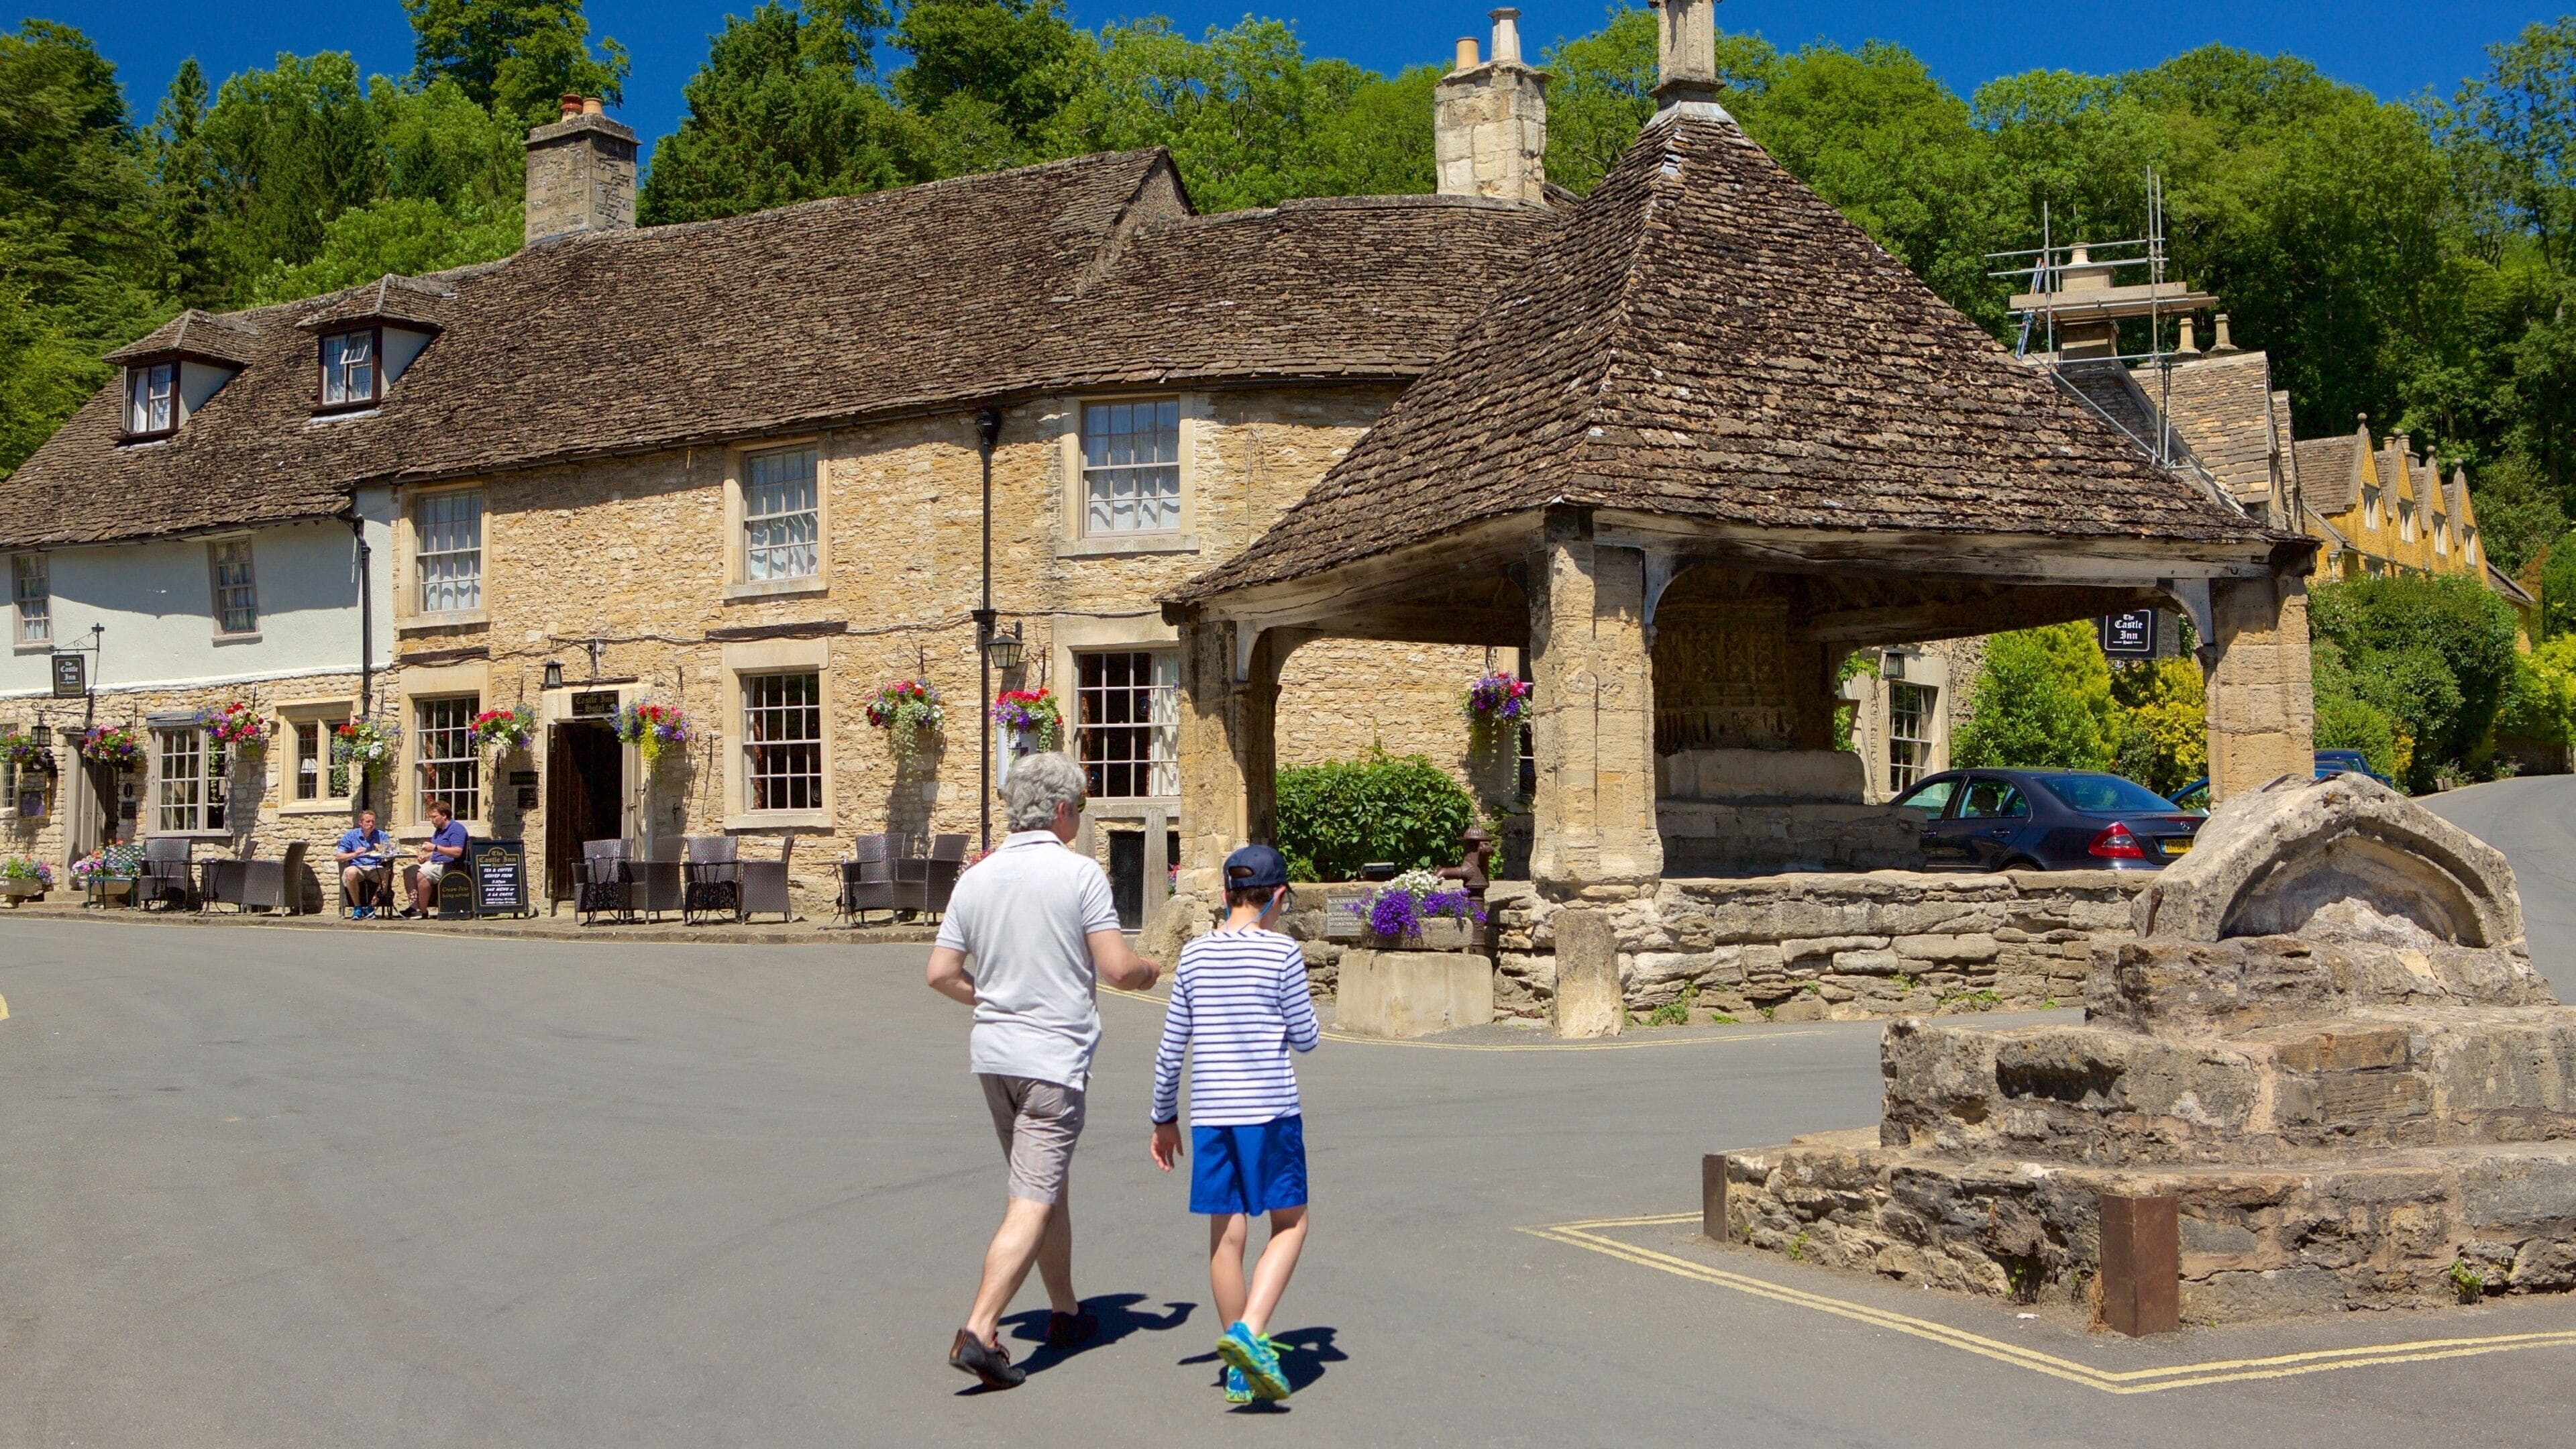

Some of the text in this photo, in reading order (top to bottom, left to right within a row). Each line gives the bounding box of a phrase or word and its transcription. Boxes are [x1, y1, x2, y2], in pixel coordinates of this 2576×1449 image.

[2114, 619, 2143, 629] Castle
[2120, 630, 2138, 639] Inn
[576, 695, 597, 704] Castle
[600, 694, 614, 703] Inn
[585, 704, 604, 713] Hotel
